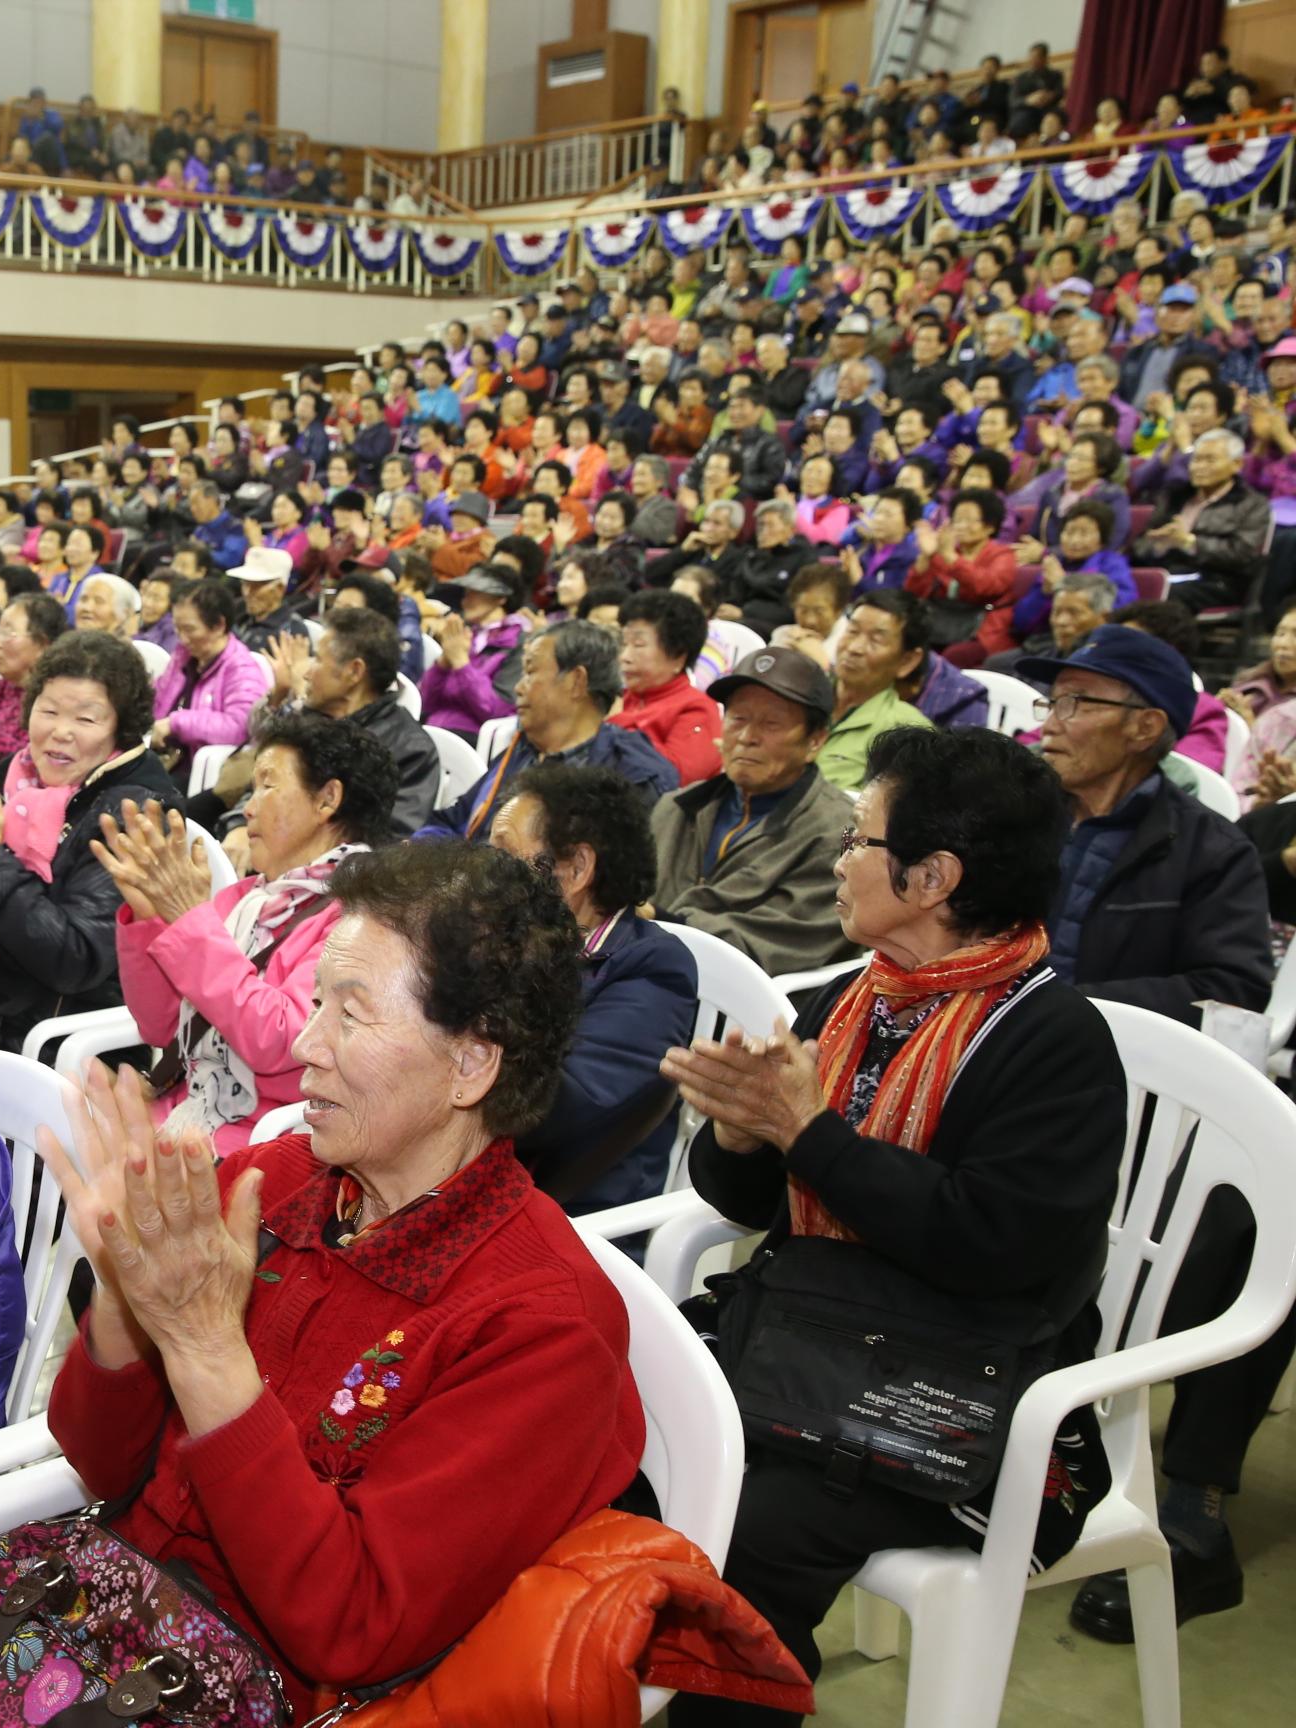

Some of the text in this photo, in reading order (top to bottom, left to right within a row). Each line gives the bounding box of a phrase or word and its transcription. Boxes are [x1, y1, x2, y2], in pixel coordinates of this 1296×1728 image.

[864, 1391, 897, 1407] elegator
[913, 1381, 956, 1400] elegator
[849, 1403, 883, 1418] elegator
[909, 1397, 953, 1415] elegator
[935, 1423, 975, 1441] elegator
[950, 1413, 994, 1433] elegator
[926, 1449, 967, 1468] elegator
